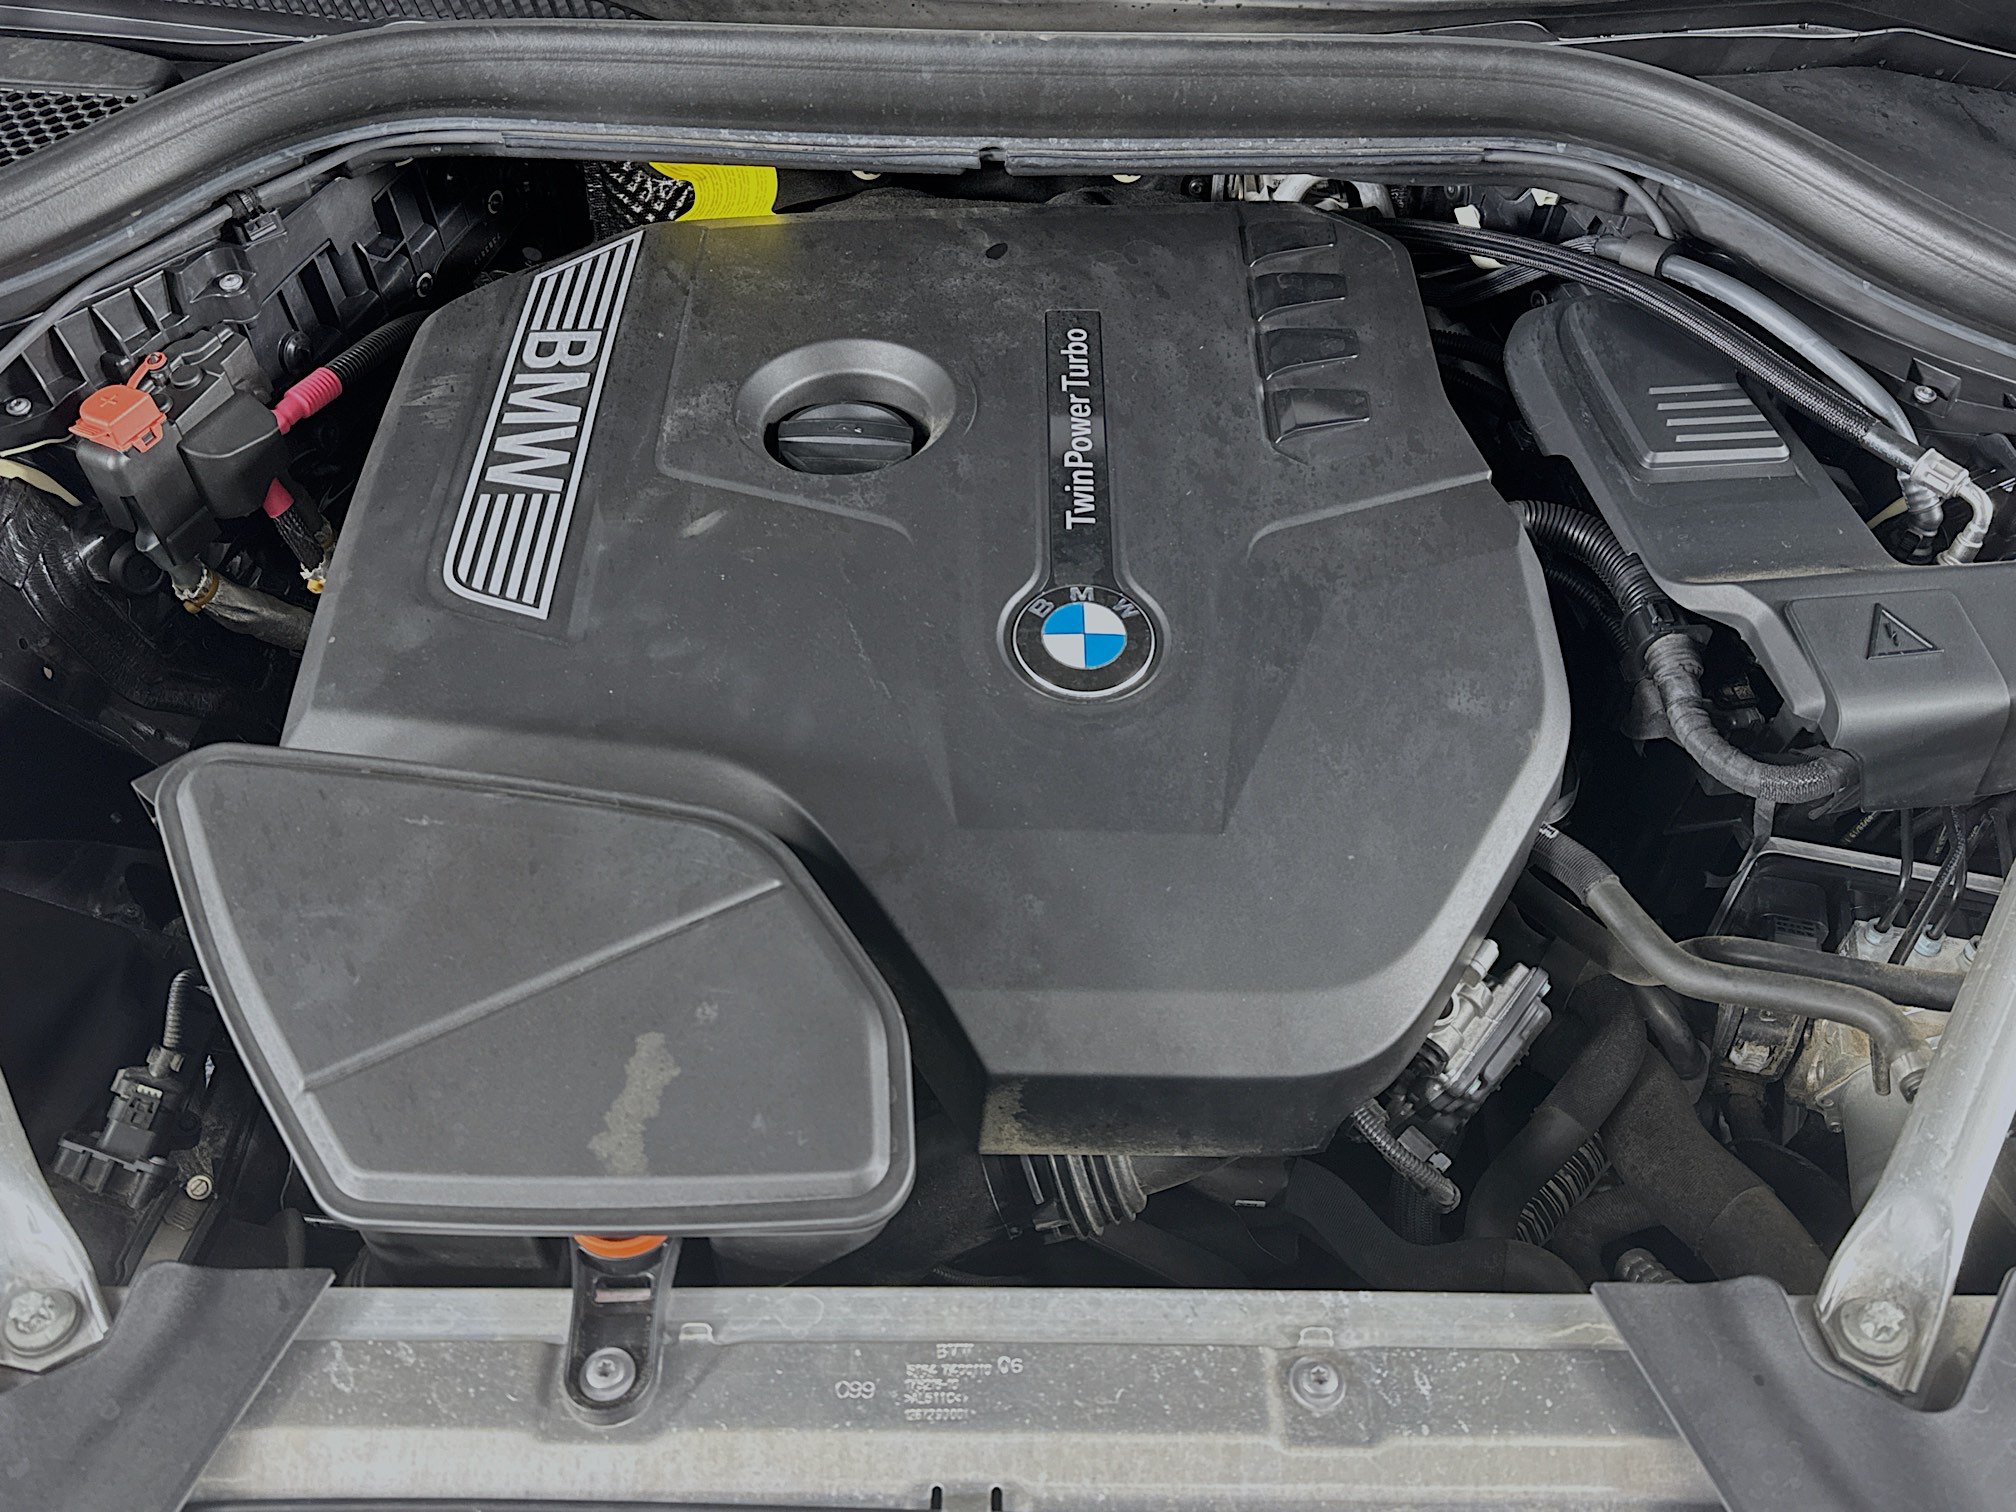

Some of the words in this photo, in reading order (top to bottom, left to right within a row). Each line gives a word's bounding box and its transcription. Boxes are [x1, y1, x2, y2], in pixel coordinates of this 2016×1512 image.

[1060, 328, 1090, 391] Turbo
[485, 331, 602, 492] BMW
[1064, 394, 1096, 530] TwinPower
[1028, 587, 1139, 620] BMW
